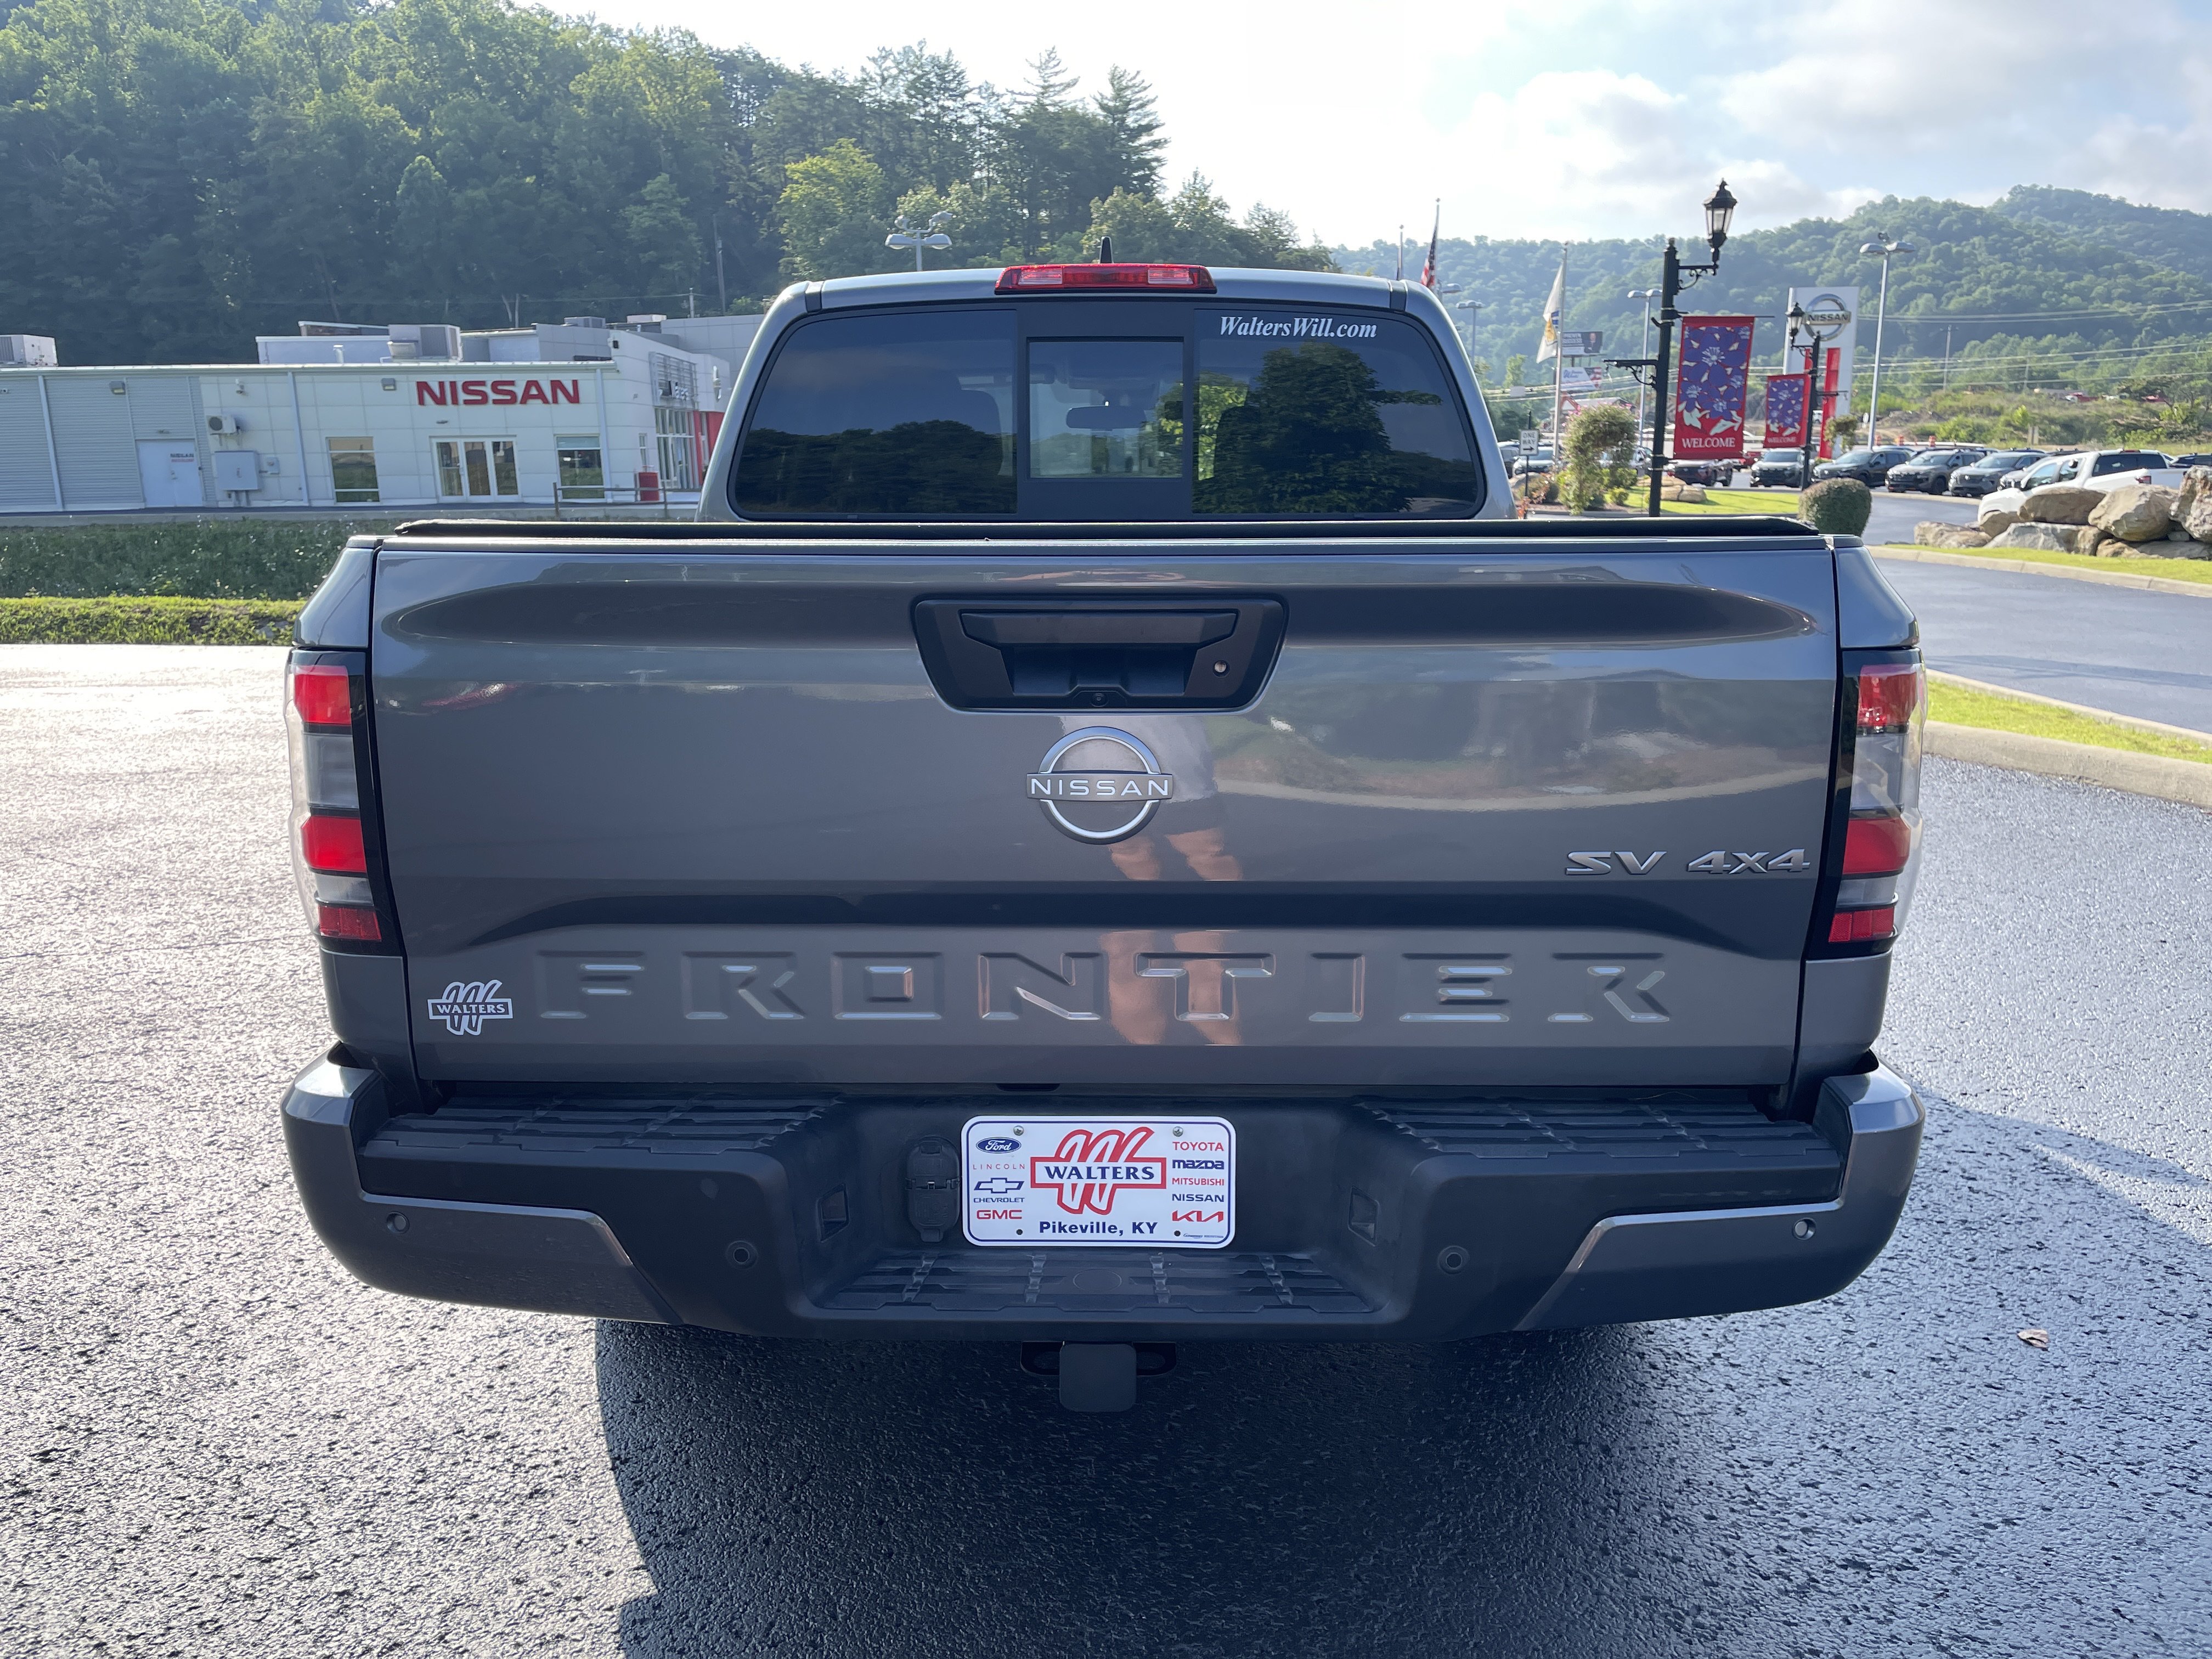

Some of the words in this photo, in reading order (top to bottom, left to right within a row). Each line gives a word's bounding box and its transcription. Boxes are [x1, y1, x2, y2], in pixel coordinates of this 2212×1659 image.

[1808, 313, 1848, 321] NISSAN
[1220, 317, 1377, 337] WaltersWill.com
[416, 379, 580, 405] NISSAN
[1681, 437, 1735, 448] WELCOME
[1031, 778, 1168, 796] NISSAN
[1566, 851, 1667, 875] SV
[535, 950, 1670, 1022] FRONTIER
[437, 1003, 505, 1014] WALTERS
[985, 1140, 1011, 1151] Ford
[1172, 1142, 1224, 1151] TOYOTA
[1044, 1166, 1154, 1181] WALTERS
[1172, 1177, 1224, 1186] MITSUBISHI
[1172, 1193, 1224, 1203] NISSAN
[977, 1210, 1022, 1220] GMC
[1172, 1210, 1223, 1222] KIA
[1039, 1221, 1124, 1236] Pikeville,
[1132, 1222, 1158, 1234] KY
